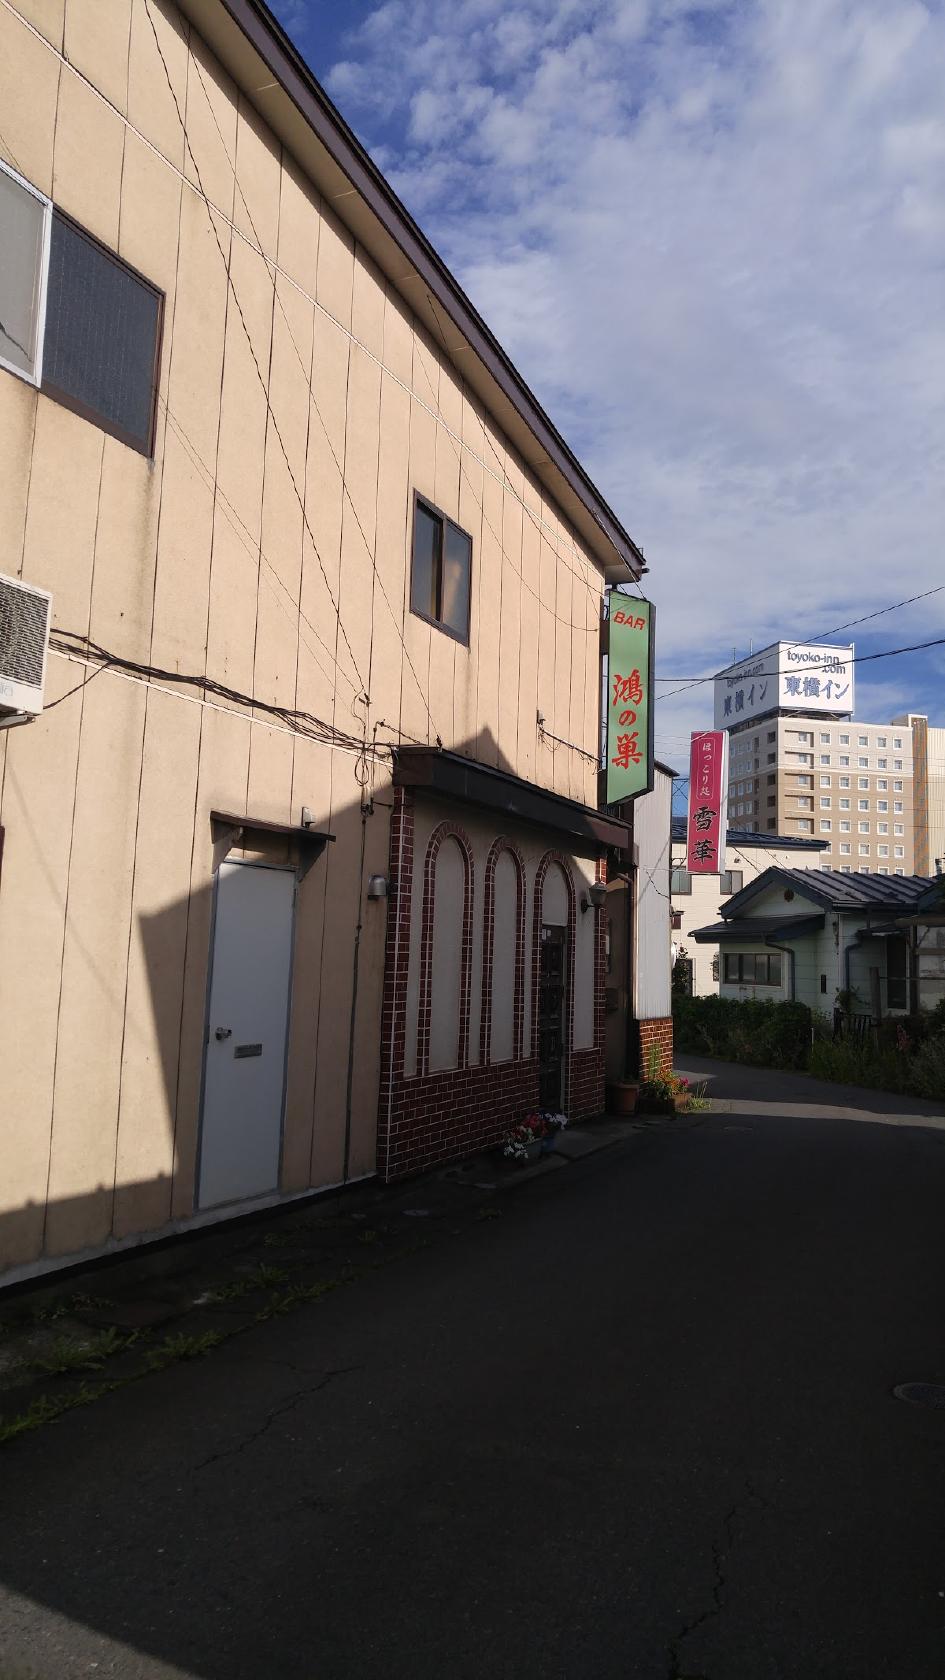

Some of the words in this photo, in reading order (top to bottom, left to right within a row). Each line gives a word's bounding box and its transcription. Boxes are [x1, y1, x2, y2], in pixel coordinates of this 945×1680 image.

[613, 611, 646, 631] BAR
[787, 650, 840, 664] toyoko-inn
[723, 680, 768, 718] 東横イン
[784, 676, 850, 700] 東横イン
[611, 669, 644, 770] 鴻の巣
[691, 806, 717, 865] 雪華
